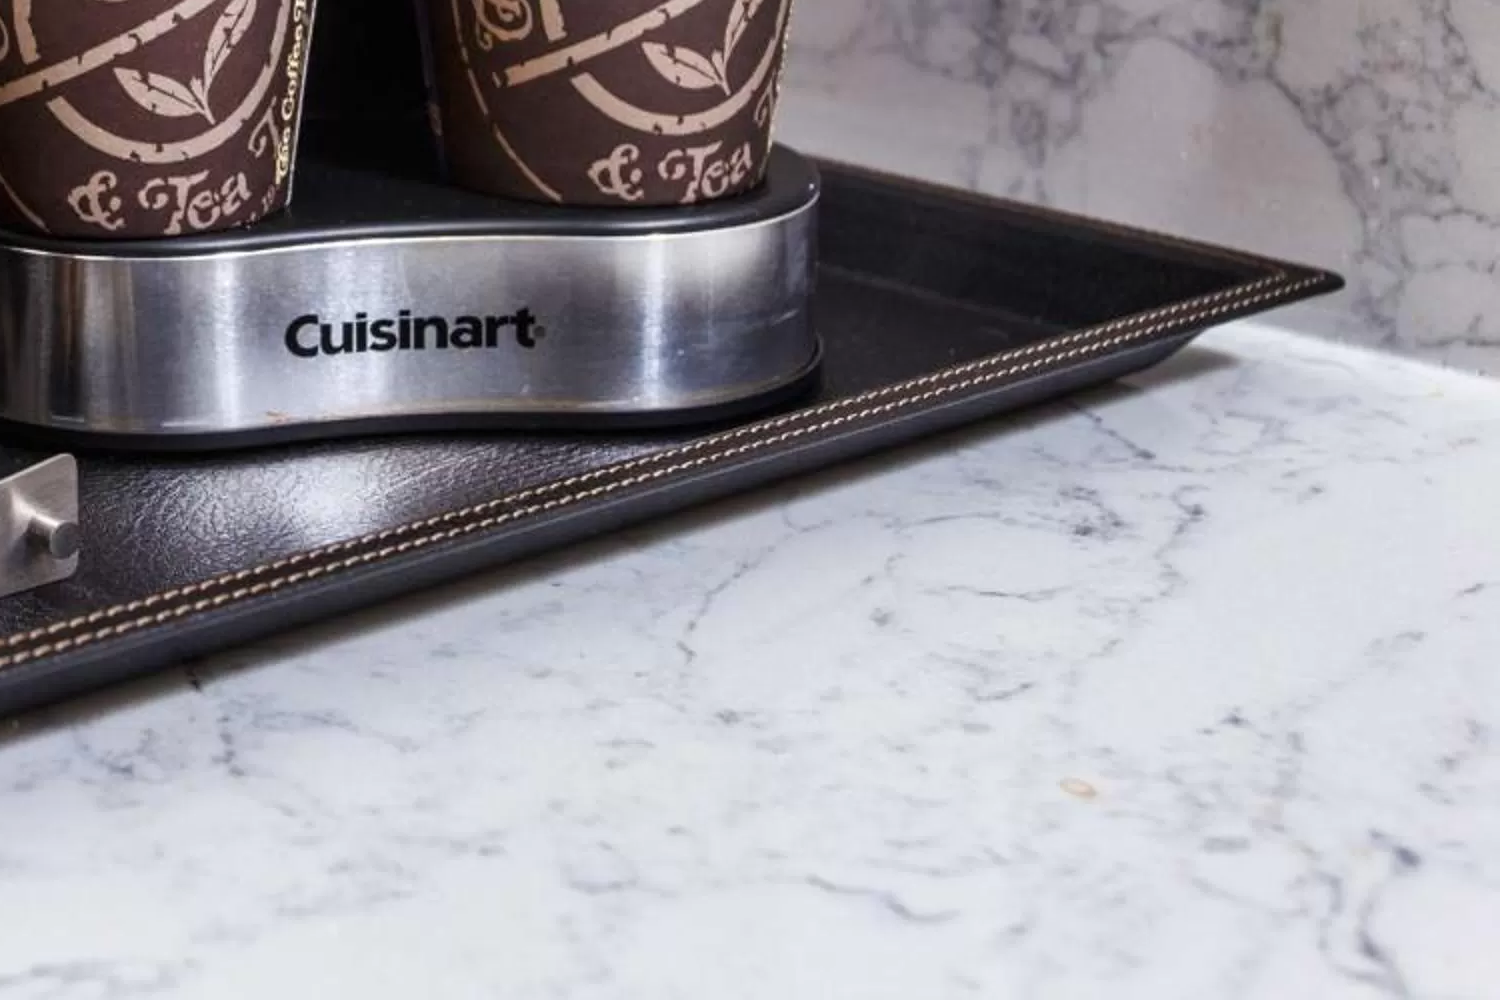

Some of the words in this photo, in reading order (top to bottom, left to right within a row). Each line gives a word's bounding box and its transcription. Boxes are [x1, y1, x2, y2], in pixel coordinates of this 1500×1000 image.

[281, 24, 303, 120] Coffee
[67, 170, 127, 231] &
[137, 169, 253, 236] Tea
[587, 142, 645, 202] &
[657, 140, 755, 204] Tea
[284, 306, 536, 358] Cuisinart
